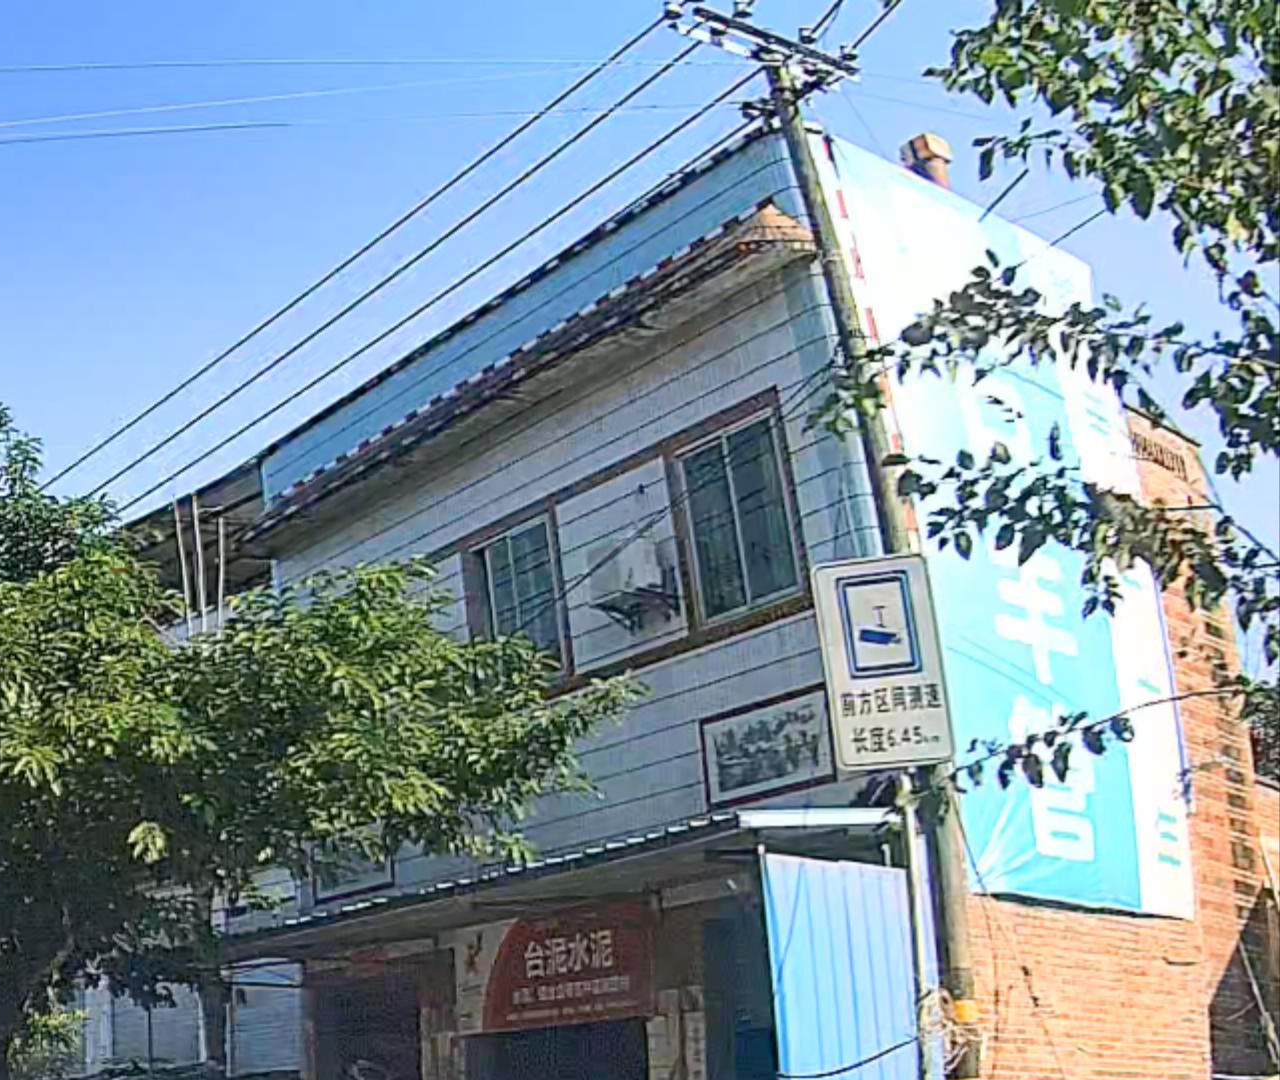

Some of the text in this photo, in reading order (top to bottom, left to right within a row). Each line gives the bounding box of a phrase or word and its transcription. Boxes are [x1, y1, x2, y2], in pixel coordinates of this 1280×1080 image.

[839, 683, 942, 717] 前方区间测速
[523, 929, 614, 979] 台泥水泥
